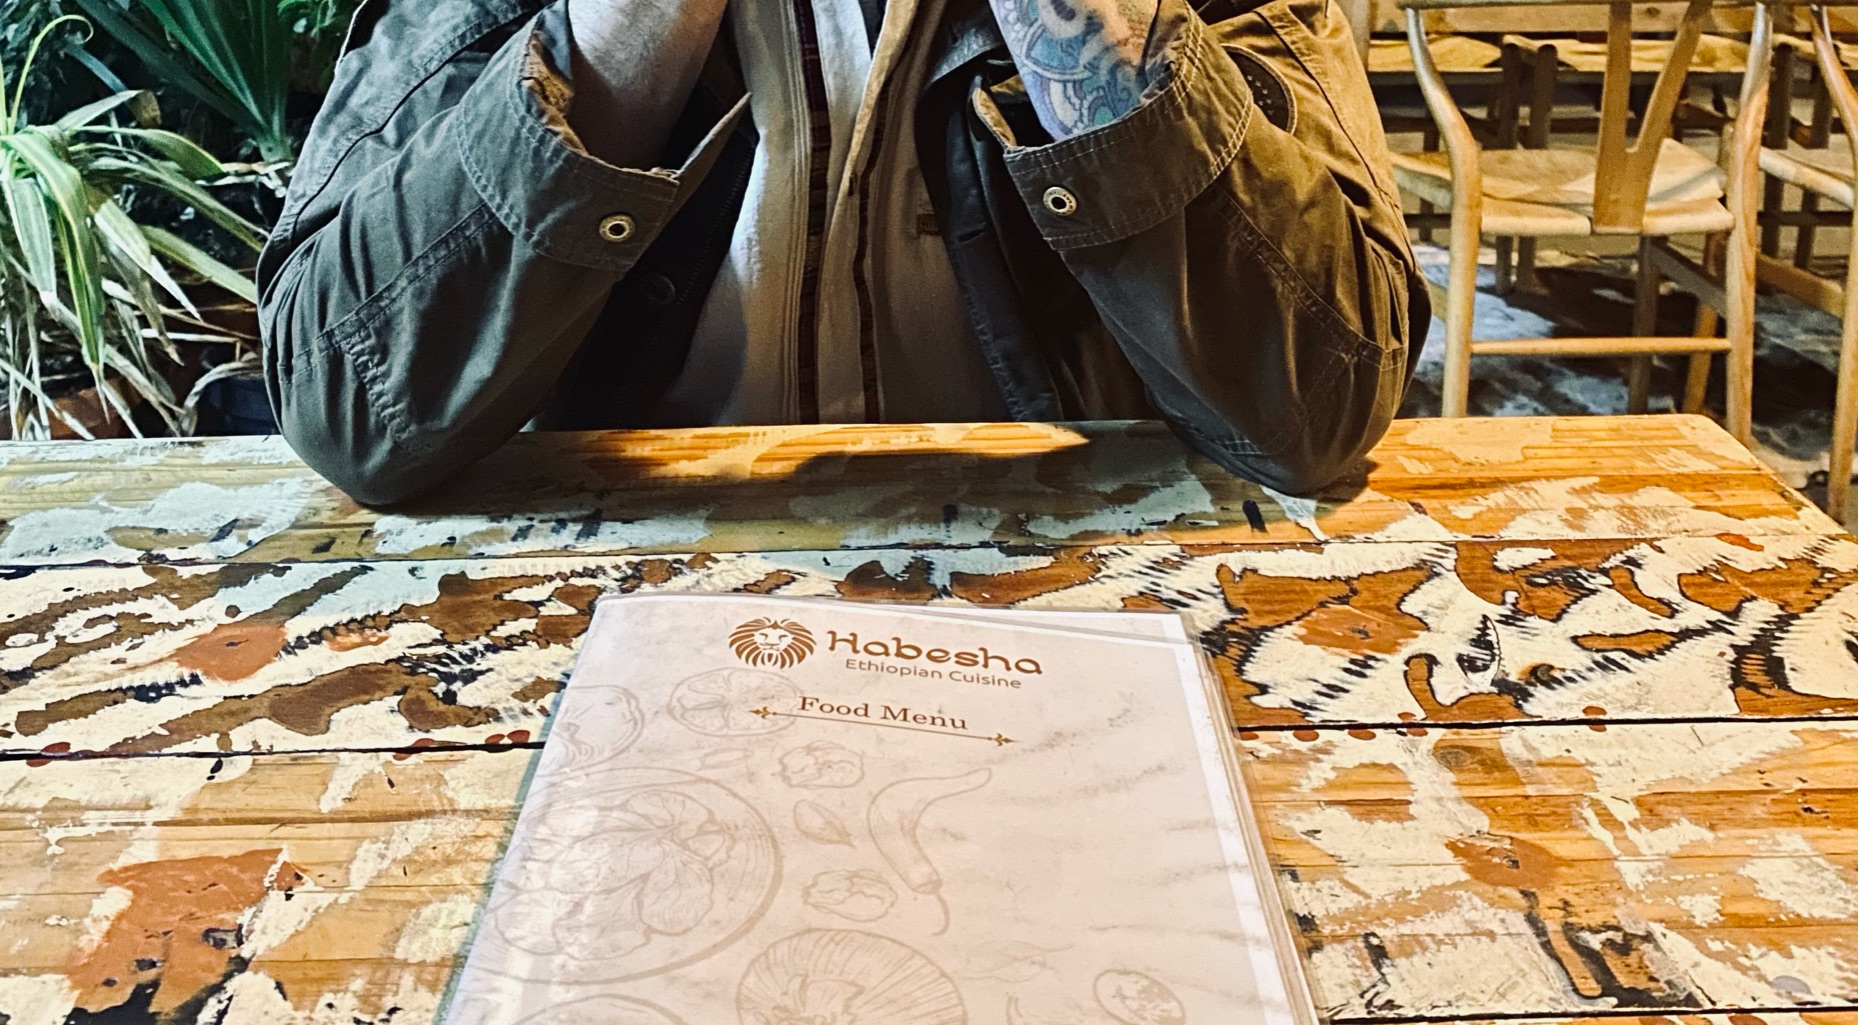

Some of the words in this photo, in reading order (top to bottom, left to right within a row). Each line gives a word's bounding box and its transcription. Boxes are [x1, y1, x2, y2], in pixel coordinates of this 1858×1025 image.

[827, 630, 1043, 675] Habesha
[845, 658, 942, 678] Ethiopian
[948, 670, 1022, 689] Cuisine
[798, 696, 870, 718] Food
[880, 705, 968, 730] Menu
